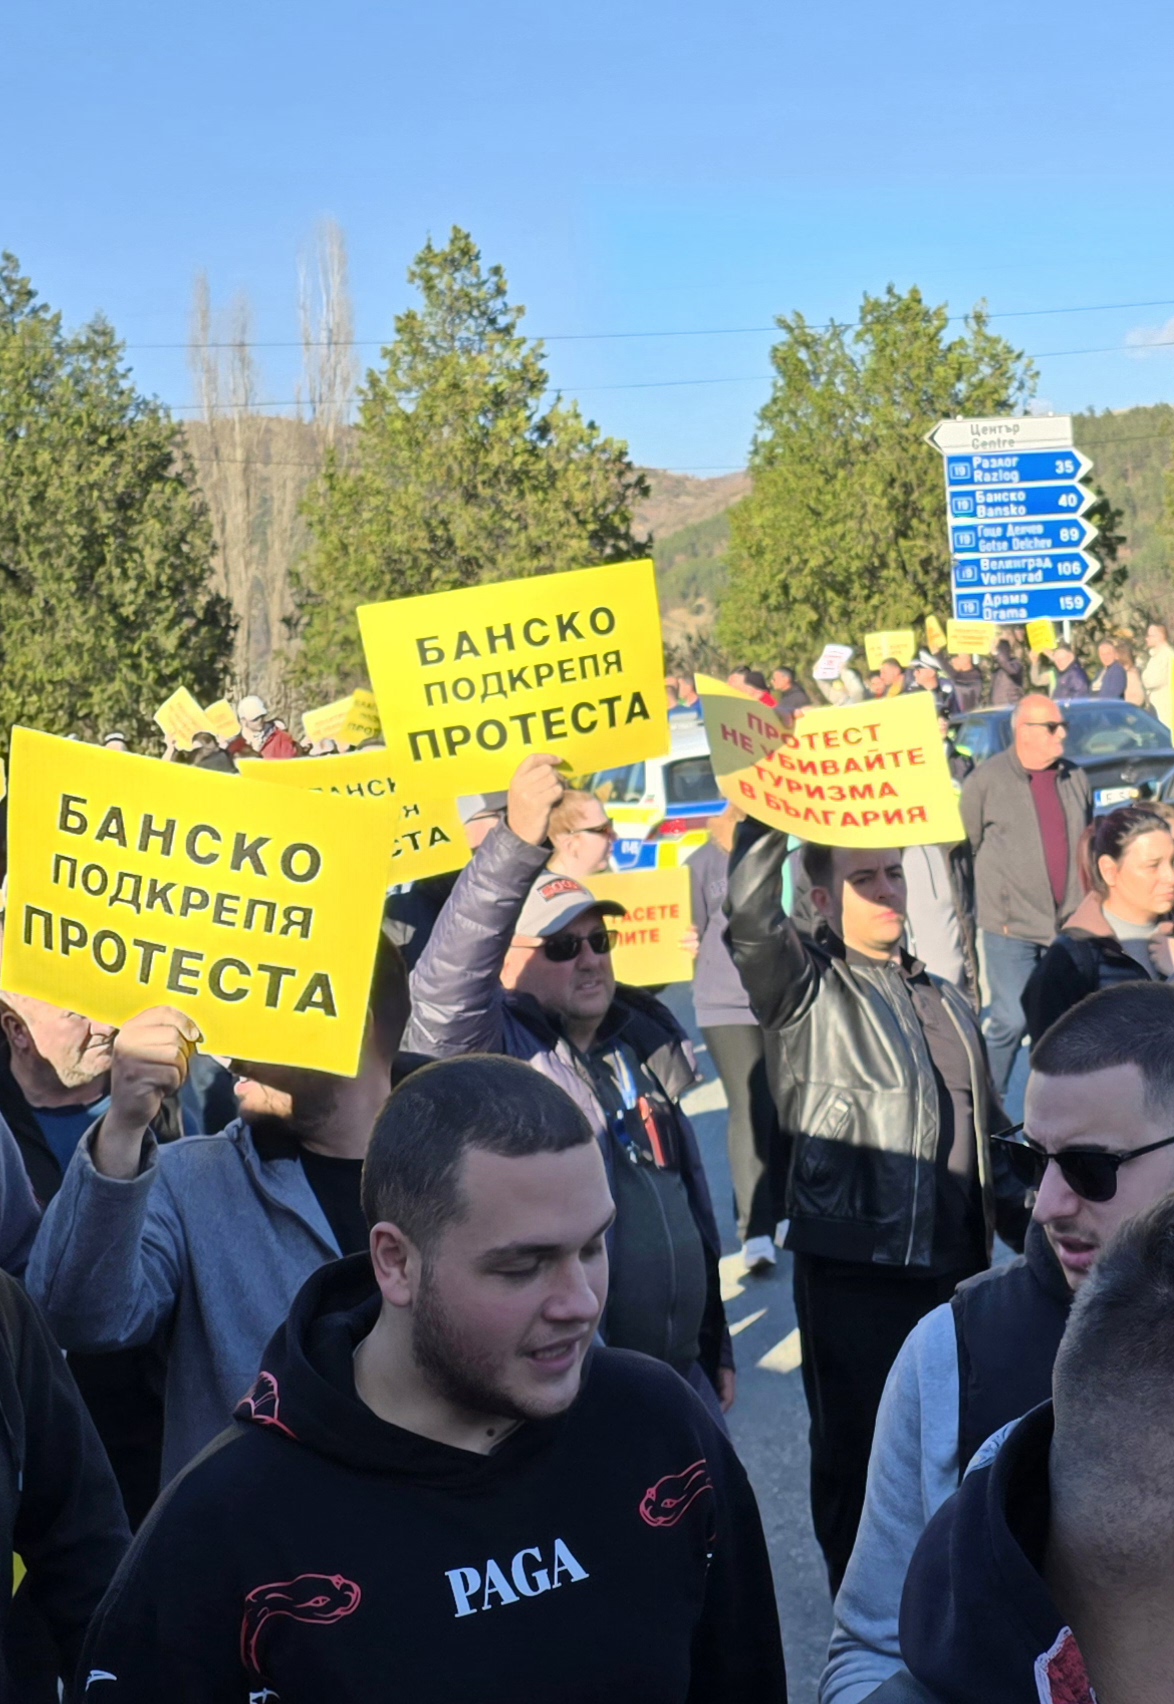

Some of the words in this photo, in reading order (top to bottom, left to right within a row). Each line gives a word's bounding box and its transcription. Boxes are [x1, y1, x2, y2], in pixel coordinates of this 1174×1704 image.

[970, 423, 1020, 436] Център
[971, 438, 1015, 450] Centre
[972, 456, 1019, 469] Разлог
[1055, 459, 1074, 474] 35
[973, 469, 1020, 483] Razlog
[975, 490, 1026, 503] Банско
[1058, 493, 1078, 507] 40
[976, 504, 1027, 518] Bansko
[977, 525, 1003, 538] Гоце
[1059, 527, 1079, 542] 89
[979, 539, 1009, 552] Gotse
[1012, 538, 1052, 550] Delchev
[980, 557, 1053, 571] Велинград
[1057, 561, 1082, 576] 106
[981, 570, 1043, 586] Velingrad
[982, 593, 1028, 608] Драма
[1059, 596, 1084, 610] 159
[982, 608, 1028, 620] Drama
[416, 607, 615, 666] БАНСКО
[424, 650, 623, 706] ПОДКРЕПЯ
[408, 692, 650, 762] ПРОТЕСТА
[747, 712, 881, 750] ПРОТЕСТ
[721, 724, 754, 755] НЕ
[760, 747, 926, 776] УБИВАЙТЕ
[755, 765, 898, 801] ТУРИЗМА
[739, 780, 757, 800] В
[764, 791, 928, 827] БЪЛГАРИЯ
[59, 794, 321, 883] БАНСКО
[53, 854, 313, 940] ПОДКРЕПЯ
[611, 904, 680, 925] АСЕТЕ
[23, 904, 338, 1018] ПРОТЕСТА
[444, 1537, 589, 1618] PAGA
